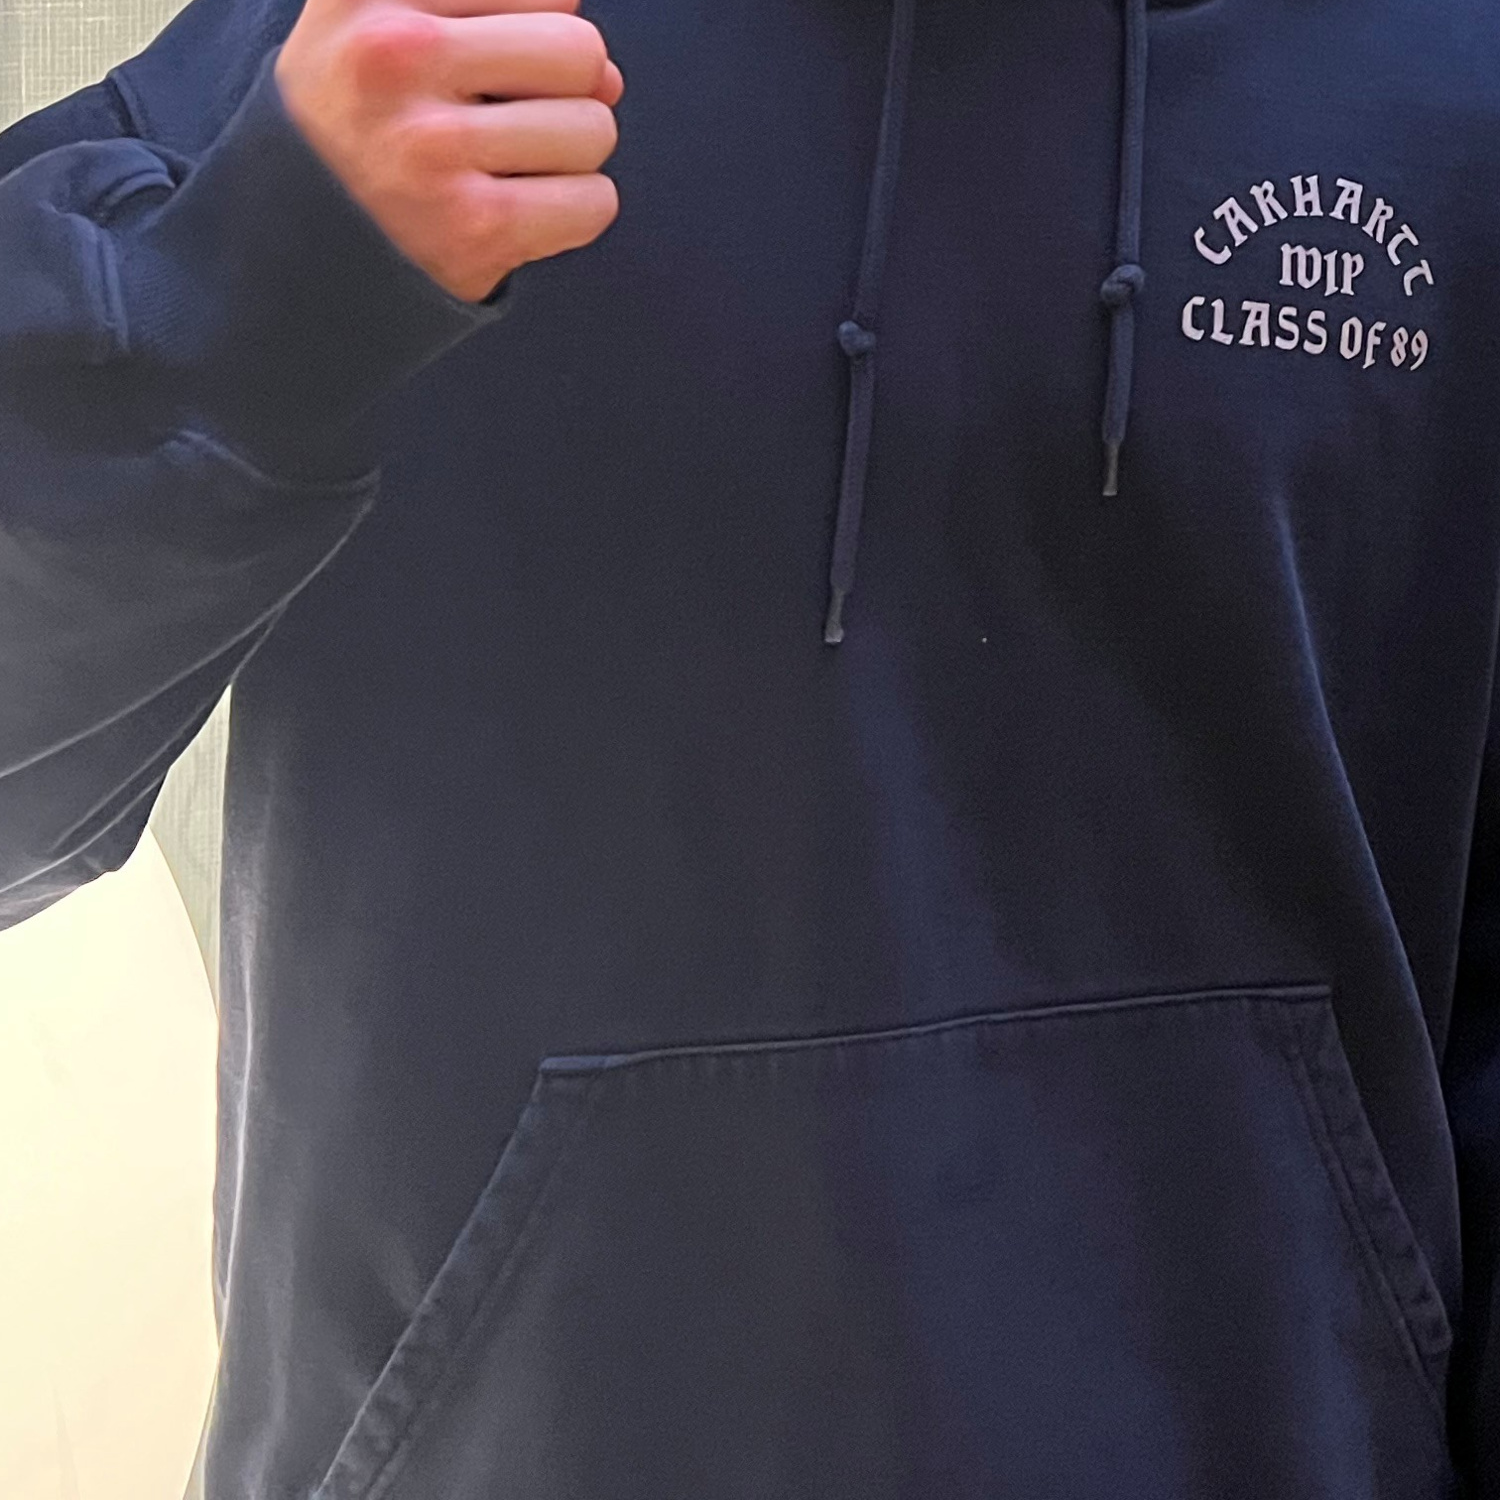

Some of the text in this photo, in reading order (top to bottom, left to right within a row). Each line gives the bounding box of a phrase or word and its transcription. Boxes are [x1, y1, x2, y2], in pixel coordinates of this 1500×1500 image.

[1193, 174, 1435, 297] CARHARTT
[1181, 296, 1328, 355] CLASS
[1390, 326, 1429, 371] 89
